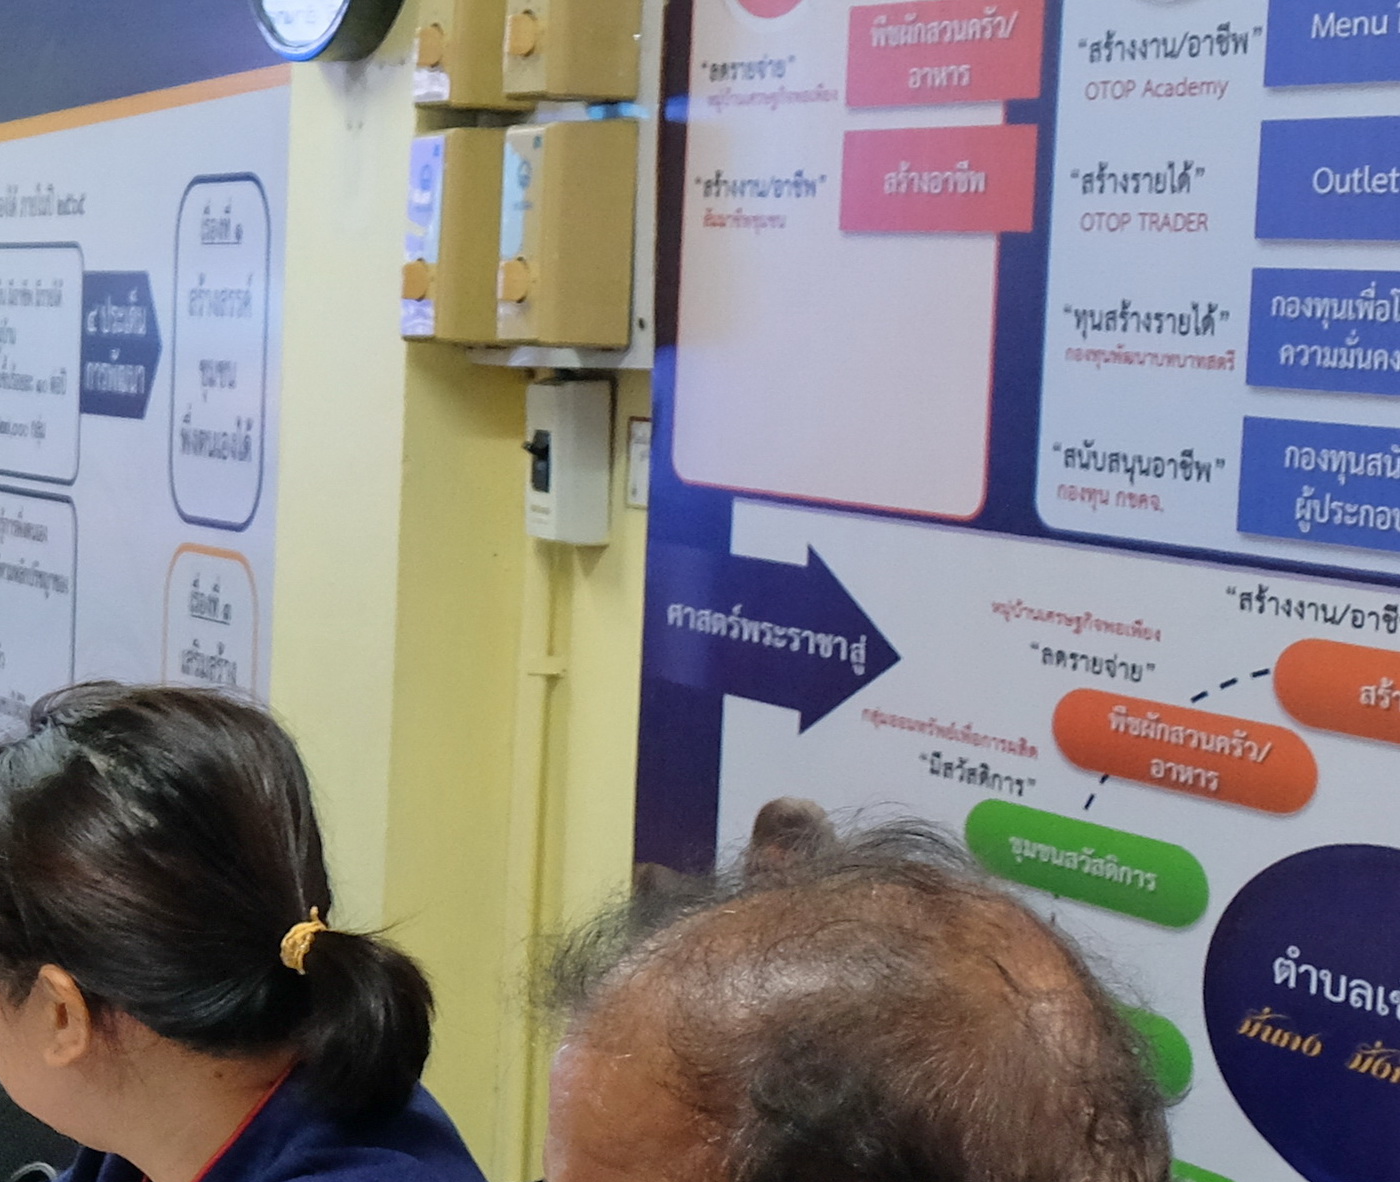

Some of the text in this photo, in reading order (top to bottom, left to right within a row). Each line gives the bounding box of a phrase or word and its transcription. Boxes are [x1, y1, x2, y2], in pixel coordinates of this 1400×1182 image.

[1310, 12, 1389, 39] Menu
[908, 64, 972, 88] อาหาร
[1084, 76, 1230, 101] OTOP Academy
[1312, 165, 1400, 195] Outlet
[1079, 211, 1209, 233] OTOP TRADER
[1226, 584, 1400, 634] “สร้างงาน/อาชี
[1150, 758, 1221, 792] อาหาร
